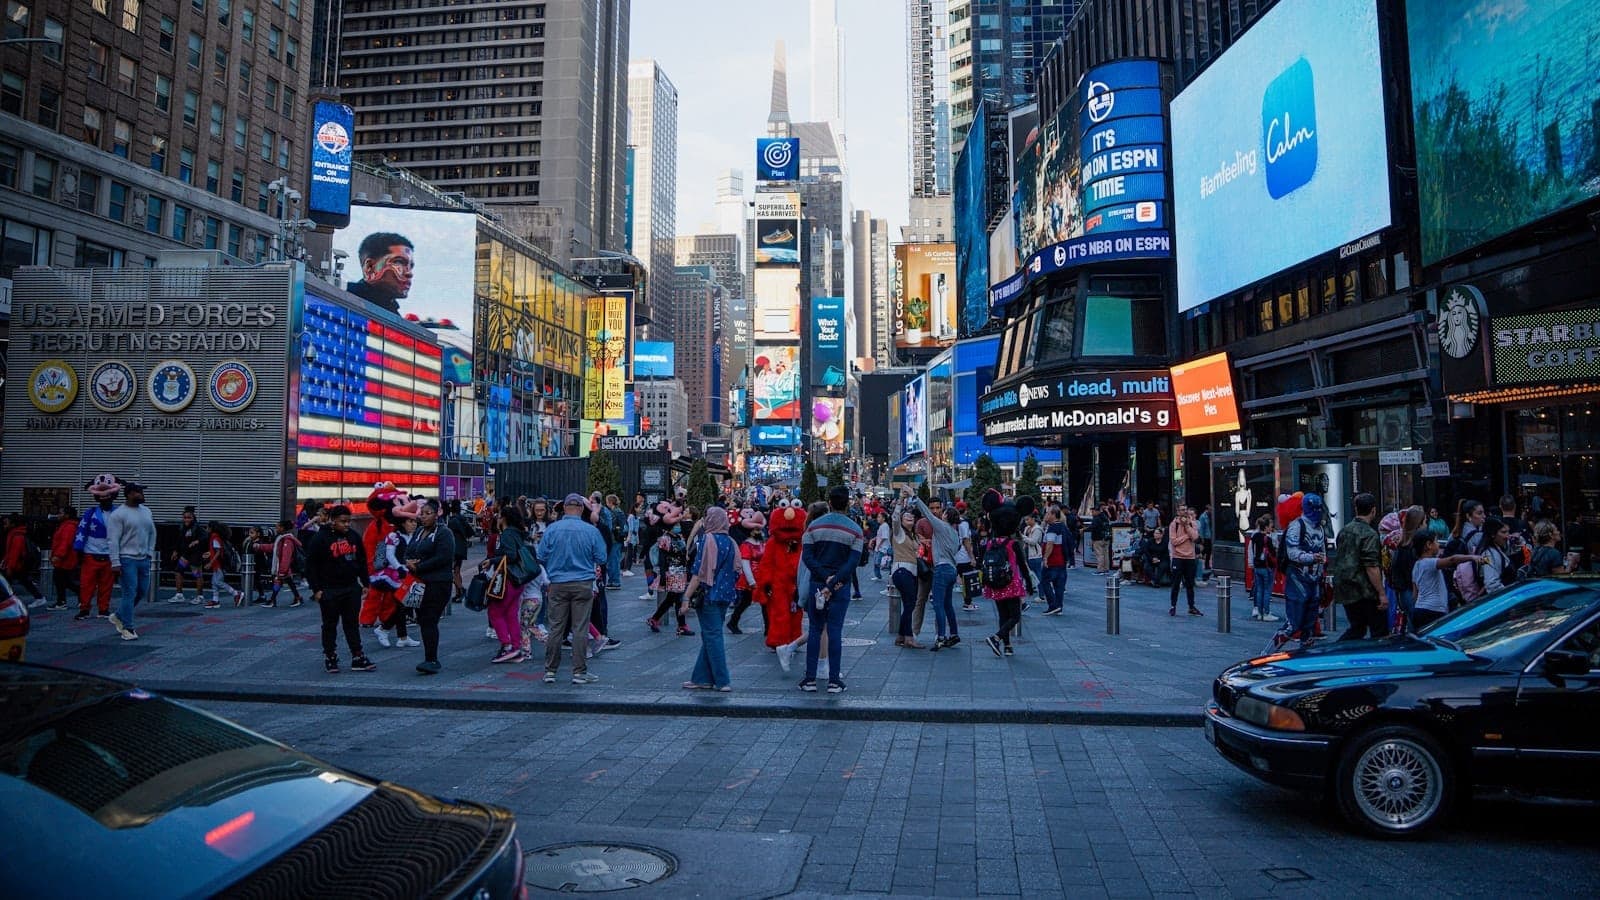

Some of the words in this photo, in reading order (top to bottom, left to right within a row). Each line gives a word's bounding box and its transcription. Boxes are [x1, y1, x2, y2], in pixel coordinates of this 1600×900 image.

[1093, 129, 1115, 153] IT'S
[1093, 155, 1108, 176] ON
[1111, 149, 1158, 171] ESPN
[1200, 149, 1256, 200] #iamfeeling
[1267, 112, 1314, 164] Calm
[314, 161, 349, 172] ENTRANCE
[313, 175, 349, 185] BROADWAY
[1092, 176, 1125, 200] TIME
[1069, 243, 1087, 259] IT'S
[1089, 240, 1112, 256] NBA
[1115, 238, 1132, 252] ON
[1136, 237, 1170, 251] ESPN
[895, 260, 904, 318] CordZero
[19, 304, 59, 327] U.S.
[64, 303, 165, 327] ARMED
[167, 302, 276, 327] FORCES
[609, 319, 623, 330] YOU
[817, 318, 837, 326] Who's
[895, 322, 904, 335] LG
[167, 332, 262, 352] STATION
[818, 332, 839, 341] Rock?
[606, 390, 622, 398] LION
[1028, 385, 1049, 401] NEWS
[1057, 382, 1063, 397] 1
[1068, 378, 1116, 397] dead,
[1122, 377, 1168, 394] multi
[605, 400, 623, 410] KING
[1177, 391, 1200, 405] Discover
[1204, 402, 1218, 416] Pies
[24, 417, 62, 431] ARMY
[125, 417, 144, 431] AIR
[205, 417, 260, 431] MARINES
[1004, 415, 1027, 433] arrested
[1028, 414, 1049, 429] after
[1051, 407, 1151, 428] McDonald's
[1157, 409, 1169, 427] g
